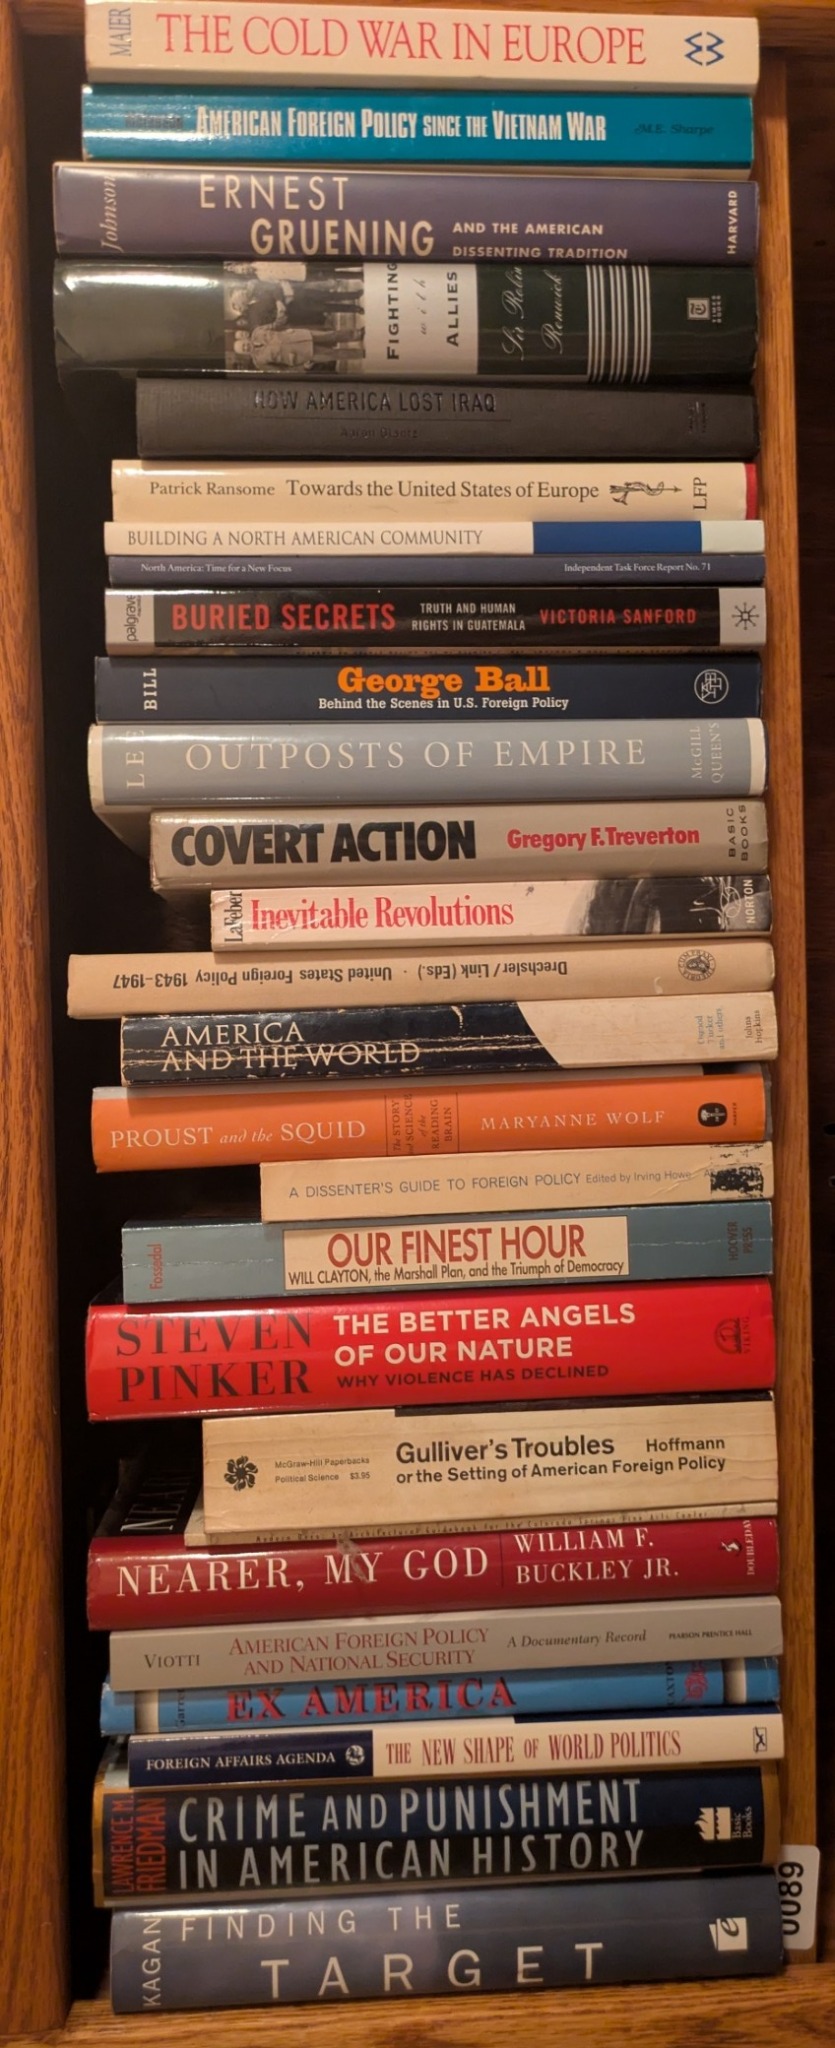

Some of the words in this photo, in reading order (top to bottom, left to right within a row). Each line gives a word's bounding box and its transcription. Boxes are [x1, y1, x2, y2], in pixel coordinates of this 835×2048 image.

[156, 13, 234, 53] THE
[242, 16, 348, 57] COLD
[357, 20, 442, 59] WAR
[452, 23, 491, 60] IN
[503, 24, 646, 65] EUROPE
[200, 175, 348, 210] ERNEST
[452, 222, 486, 234] AND
[492, 222, 519, 235] THE
[525, 223, 604, 235] AMERICAN
[727, 189, 738, 255] HARVARD
[251, 218, 434, 257] GRUENING
[452, 246, 542, 259] DISSENTING
[548, 247, 628, 260] TRADITION
[387, 263, 399, 360] FIGHTING
[446, 271, 459, 347] ALLIES
[306, 391, 391, 411] AMERICA
[150, 481, 201, 496] Patrick
[206, 482, 275, 496] Ransome
[286, 480, 363, 497] Towards
[367, 480, 393, 497] the
[398, 481, 456, 498] United
[460, 481, 511, 498] States
[515, 480, 535, 498] of
[127, 530, 208, 546] BUILDING
[212, 531, 224, 546] A
[228, 530, 286, 546] NORTH
[292, 530, 375, 546] AMERICAN
[380, 530, 483, 545] COMMUNITY
[141, 563, 167, 572] North
[169, 563, 204, 573] America:
[205, 563, 226, 572] Time
[228, 563, 240, 572] for
[248, 563, 265, 572] New
[268, 563, 292, 572] Focus
[564, 563, 613, 573] Independent
[614, 563, 632, 572] Task
[634, 563, 655, 572] Force
[656, 563, 684, 573] Report
[685, 563, 700, 572] No.
[702, 563, 711, 572] 71
[171, 604, 270, 631] BURIED
[281, 603, 396, 631] SECRETS
[420, 603, 452, 614] TRUTH
[456, 603, 476, 614] AND
[480, 603, 516, 614] HUMAN
[539, 608, 615, 624] VICTORIA
[622, 608, 697, 624] SANFORD
[411, 619, 450, 631] RIGHTS
[453, 619, 464, 631] IN
[467, 620, 526, 631] GUATEMALA
[143, 668, 158, 711] BILL
[337, 667, 463, 700] George
[475, 666, 550, 692] Ball
[318, 698, 363, 710] Behind
[366, 698, 386, 709] the
[390, 698, 434, 709] Scenes
[437, 698, 449, 709] in
[453, 698, 478, 709] U.S.
[482, 697, 529, 711] Foreign
[185, 741, 404, 771] OUTPOSTS
[424, 741, 474, 768] OF
[494, 739, 646, 767] EMPIRE
[690, 726, 702, 779] McGILL
[171, 823, 325, 867] COVERT
[330, 820, 476, 862] ACTION
[507, 828, 586, 852] Gregory
[726, 808, 736, 857] BASIC
[739, 805, 748, 861] BOOKS
[251, 898, 368, 930] Inevitable
[374, 894, 514, 928] Revolutions
[745, 879, 754, 924] NORTON
[242, 968, 293, 985] Foreign
[299, 967, 343, 982] States
[349, 966, 392, 981] United
[503, 961, 568, 975] Drechsler
[160, 1021, 305, 1047] AMERICA
[744, 1016, 752, 1039] Johns
[161, 1049, 233, 1072] AND
[305, 1042, 420, 1067] WORLD
[392, 1100, 400, 1136] STORY
[404, 1094, 414, 1141] SCIENCE
[430, 1099, 439, 1149] READING
[443, 1107, 452, 1141] BRAIN
[481, 1113, 597, 1131] MARYANNE
[607, 1111, 666, 1125] WOLF
[110, 1127, 213, 1148] PROUST
[280, 1120, 365, 1144] SQUID
[289, 1187, 299, 1198] A
[306, 1182, 393, 1198] DISSENTER'S
[399, 1179, 440, 1193] GUIDE
[472, 1175, 528, 1189] FOREIGN
[535, 1173, 581, 1186] POLICY
[586, 1173, 616, 1184] Edited
[664, 1169, 691, 1180] Howe
[328, 1232, 391, 1268] OUR
[401, 1228, 492, 1265] FINEST
[500, 1223, 586, 1260] HOUR
[555, 1260, 566, 1273] of
[567, 1259, 625, 1275] Democracy
[116, 1311, 312, 1356] STEVEN
[333, 1313, 389, 1336] THE
[400, 1309, 510, 1333] BETTER
[520, 1303, 636, 1329] ANGELS
[334, 1344, 374, 1367] OF
[384, 1341, 447, 1364] OUR
[458, 1337, 573, 1361] NATURE
[117, 1359, 313, 1402] PINKER
[337, 1375, 378, 1389] WHY
[385, 1371, 474, 1386] VIOLENCE
[480, 1369, 515, 1382] HAS
[521, 1365, 609, 1380] DECLINED
[511, 1435, 615, 1458] Troubles
[646, 1437, 725, 1452] Hoffmann
[325, 1458, 370, 1467] Paperbacks
[447, 1466, 507, 1482] Setting
[531, 1462, 608, 1478] American
[612, 1459, 674, 1475] Foreign
[678, 1456, 726, 1472] Policy
[275, 1475, 306, 1483] Political
[308, 1473, 339, 1481] Science
[350, 1472, 370, 1480] $3.95
[514, 1529, 624, 1553] WILLIAM
[403, 1547, 488, 1580] GOD
[516, 1560, 632, 1584] BUCKLEY
[335, 1632, 416, 1650] FOREIGN
[423, 1627, 489, 1644] POLICY
[507, 1636, 516, 1648] A
[521, 1631, 600, 1648] Documentary
[605, 1629, 646, 1644] Record
[144, 1654, 200, 1668] VIOTTI
[244, 1660, 283, 1676] AND
[290, 1655, 383, 1673] NATIONAL
[386, 1650, 475, 1668] SECURITY
[226, 1688, 285, 1722] EX
[302, 1677, 516, 1717] AMERICA
[146, 1756, 211, 1771] FOREIGN
[214, 1754, 272, 1768] AFFAIRS
[276, 1751, 336, 1764] AGENDA
[178, 1793, 305, 1843] CRIME
[322, 1793, 387, 1830] AND
[401, 1779, 640, 1833] PUNISHMENT
[239, 1838, 450, 1887] AMERICAN
[473, 1829, 644, 1875] HISTORY
[181, 1909, 356, 1942] FINDING
[388, 1904, 461, 1931] THE
[260, 1942, 603, 1999] TARGET
